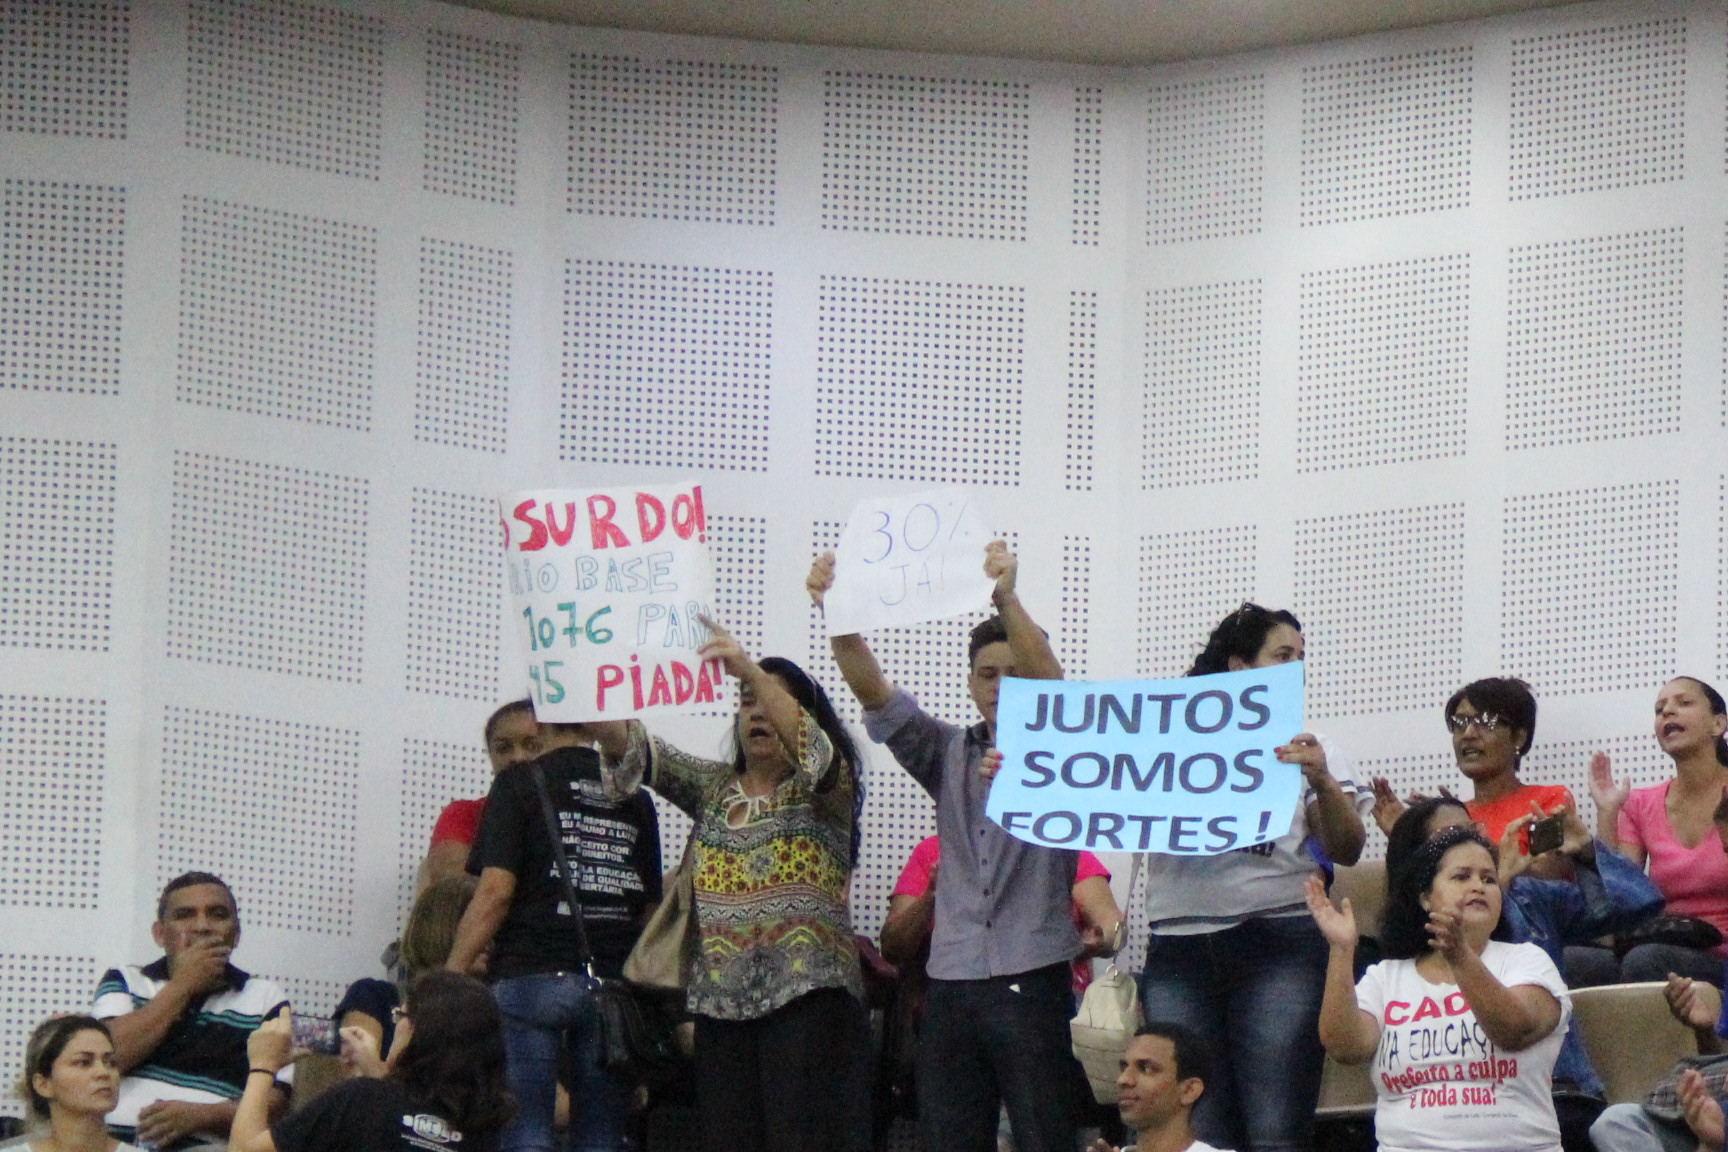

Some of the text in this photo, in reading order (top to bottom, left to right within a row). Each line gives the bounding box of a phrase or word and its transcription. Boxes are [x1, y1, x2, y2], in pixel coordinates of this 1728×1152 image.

[499, 485, 706, 552] SURDO!
[863, 500, 968, 564] 30%
[575, 551, 679, 595] BASE
[522, 601, 614, 651] 1076
[596, 653, 724, 712] PIADA!
[1024, 684, 1272, 734] JUNTOS
[1021, 749, 1265, 794] SOMOS
[573, 812, 582, 820] M
[1000, 810, 1239, 852] FORTES
[581, 841, 609, 851] CEITO
[1379, 1018, 1494, 1070] NA EDUCAÇ
[1381, 1055, 1518, 1094] Prefeito a culpa
[1420, 1084, 1457, 1108] toda
[1462, 1082, 1497, 1106] sua!
